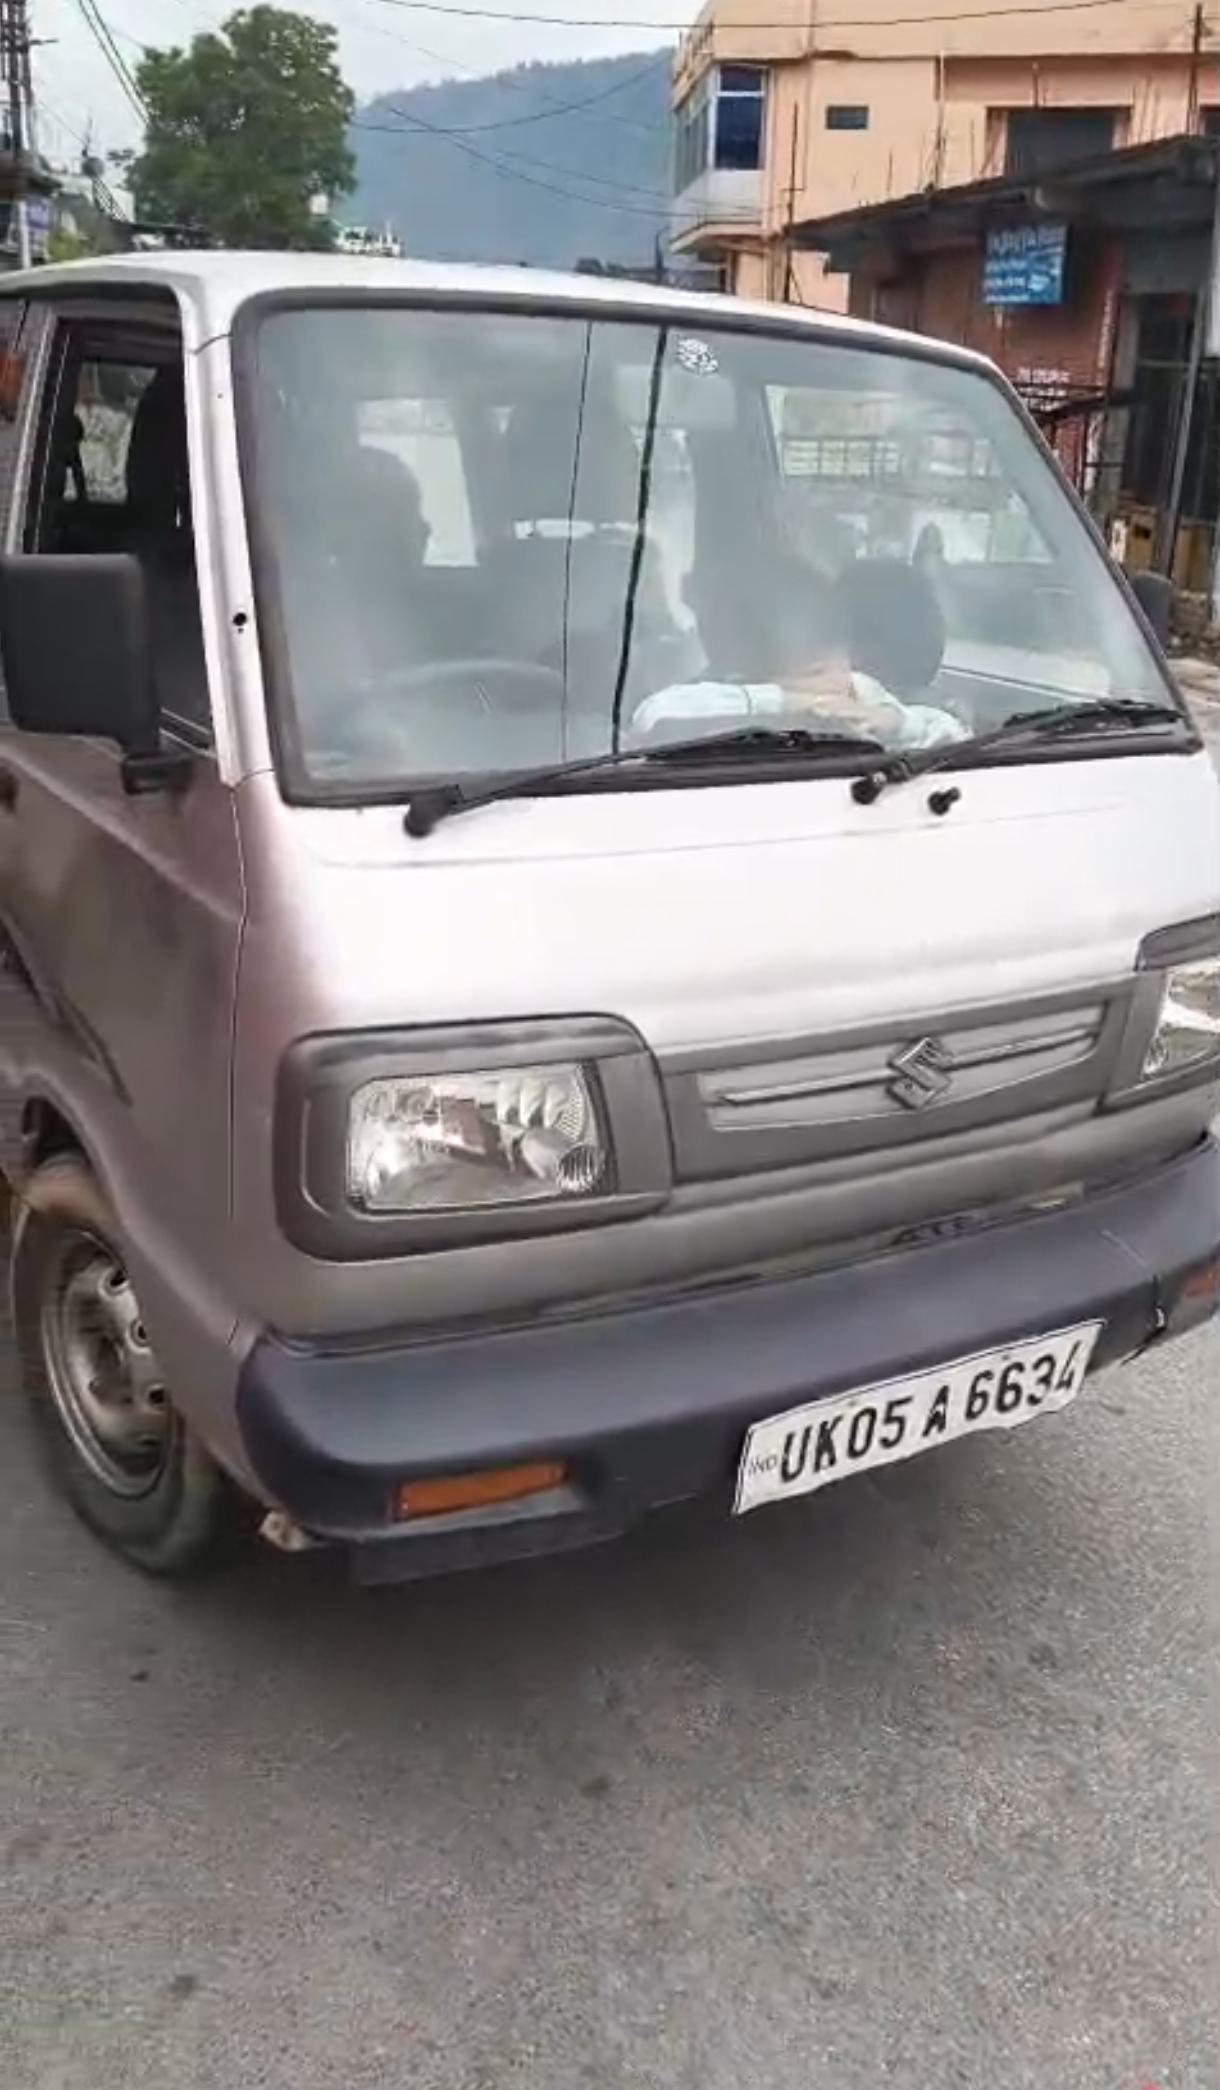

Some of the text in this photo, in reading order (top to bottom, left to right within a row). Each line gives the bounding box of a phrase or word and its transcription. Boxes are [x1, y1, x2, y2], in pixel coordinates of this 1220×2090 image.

[782, 1396, 914, 1482] UK05
[922, 1385, 950, 1437] A
[966, 1339, 1082, 1421] 6634
